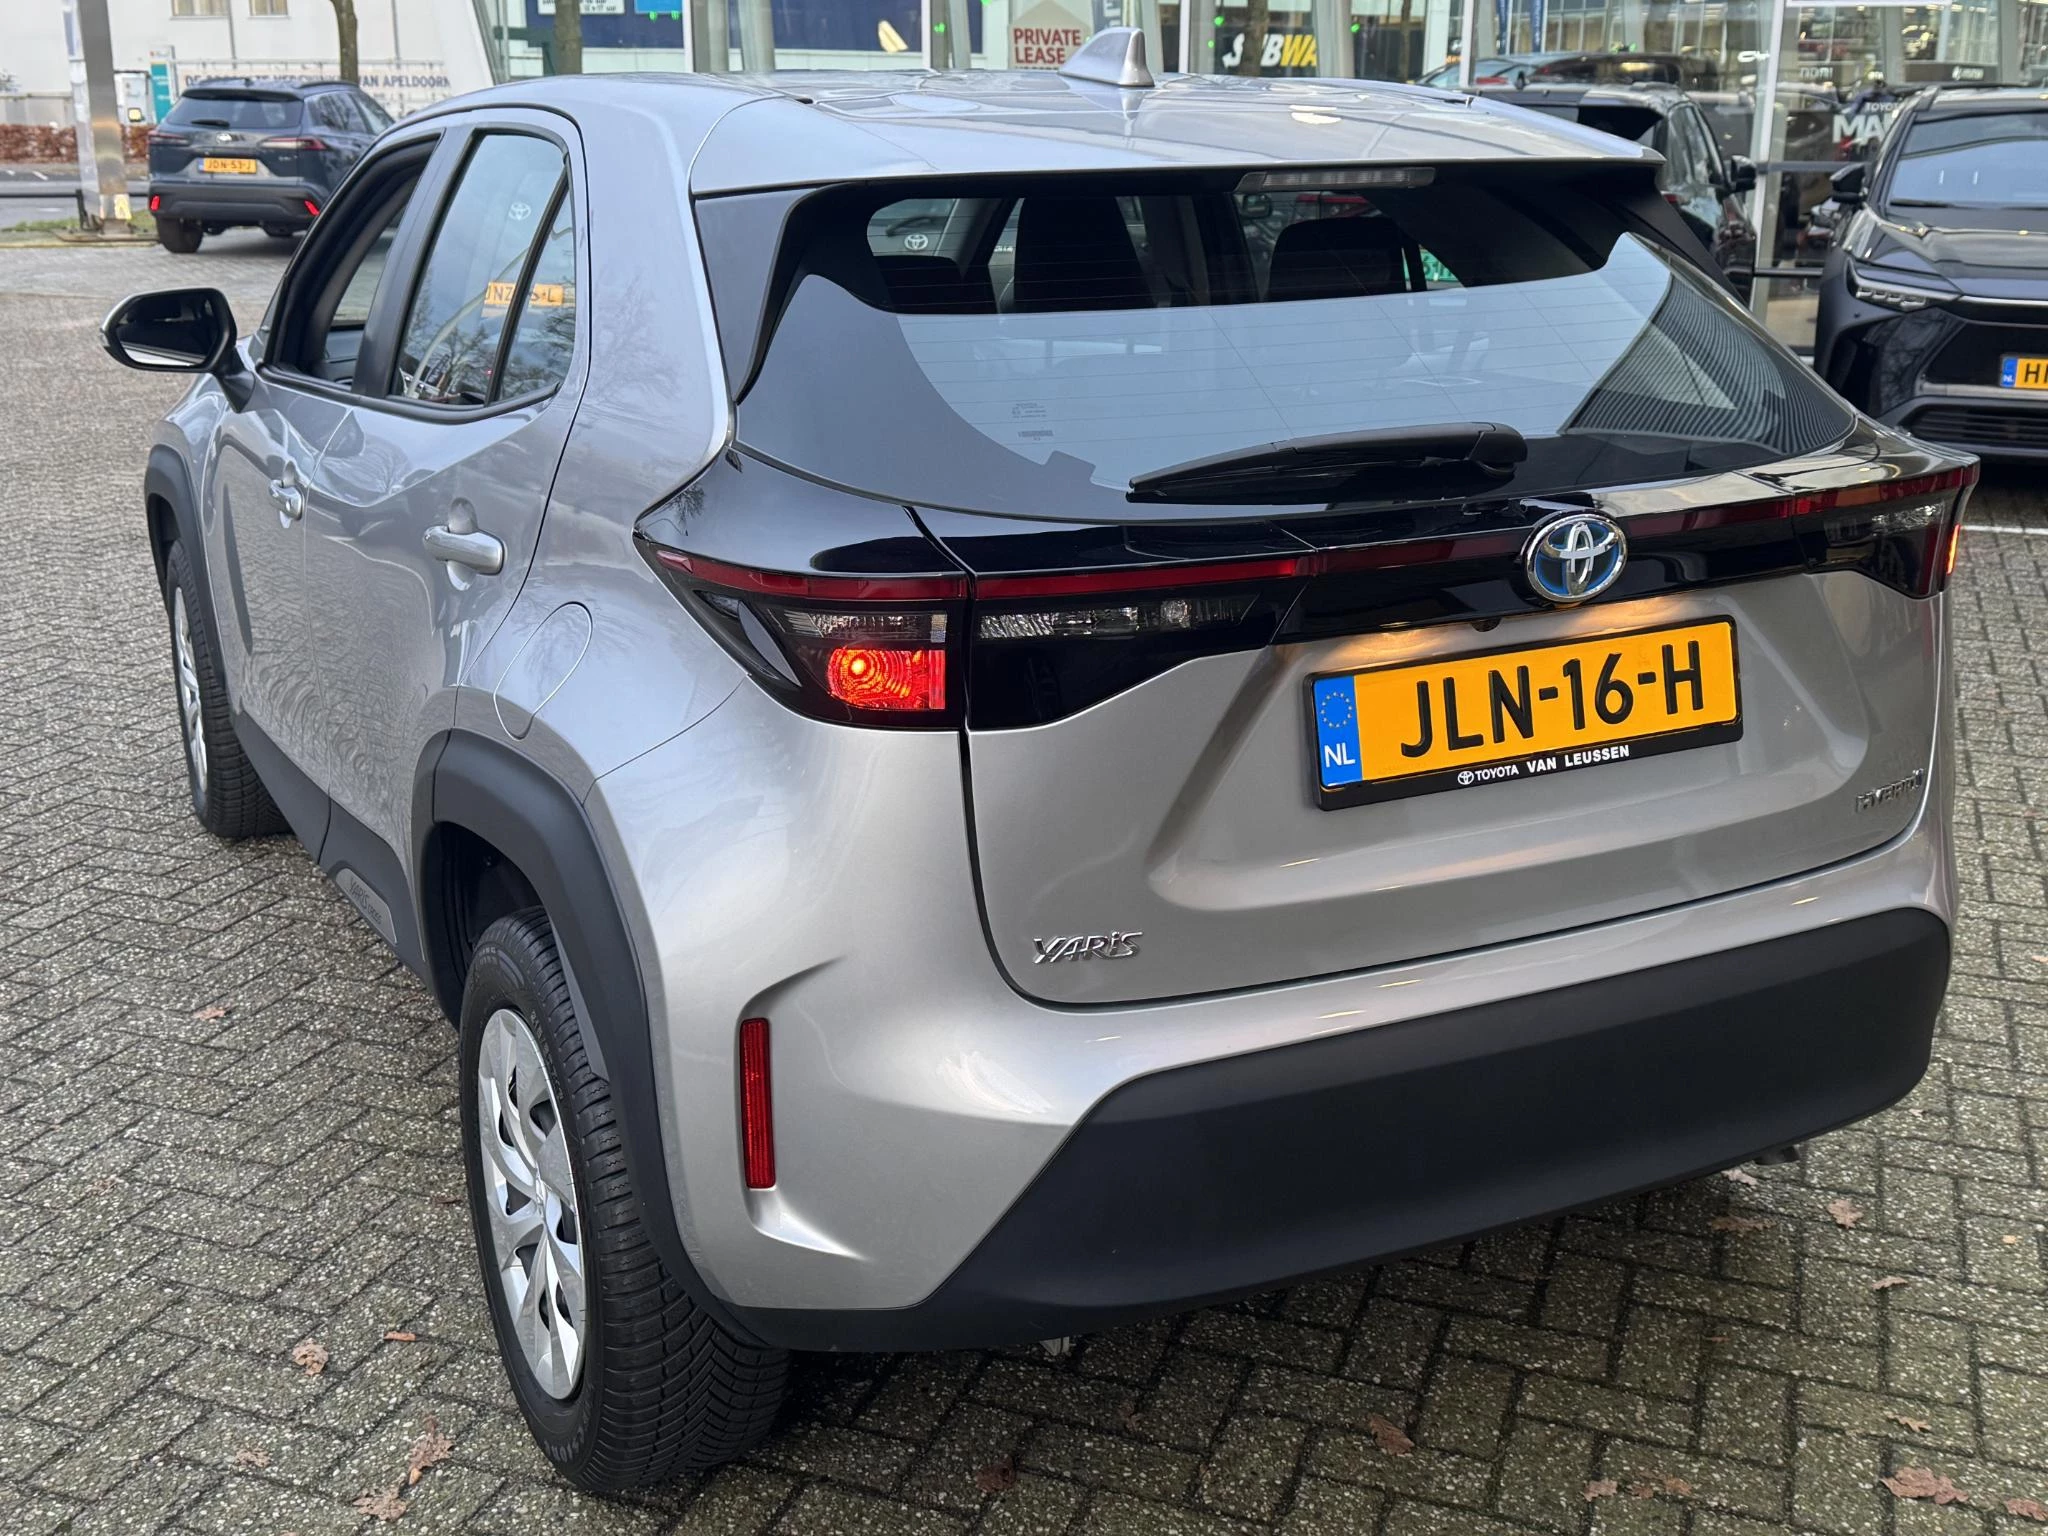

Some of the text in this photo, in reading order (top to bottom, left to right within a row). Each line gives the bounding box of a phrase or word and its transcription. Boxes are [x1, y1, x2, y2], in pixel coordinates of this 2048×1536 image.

[1013, 28, 1083, 46] PRIVATE
[1222, 33, 1317, 69] SBWA
[1015, 47, 1066, 64] LEASE
[1401, 640, 1704, 758] JLN-16-H
[1324, 742, 1356, 768] NL
[1475, 745, 1630, 781] TOYOTA VAN LEUSSEN
